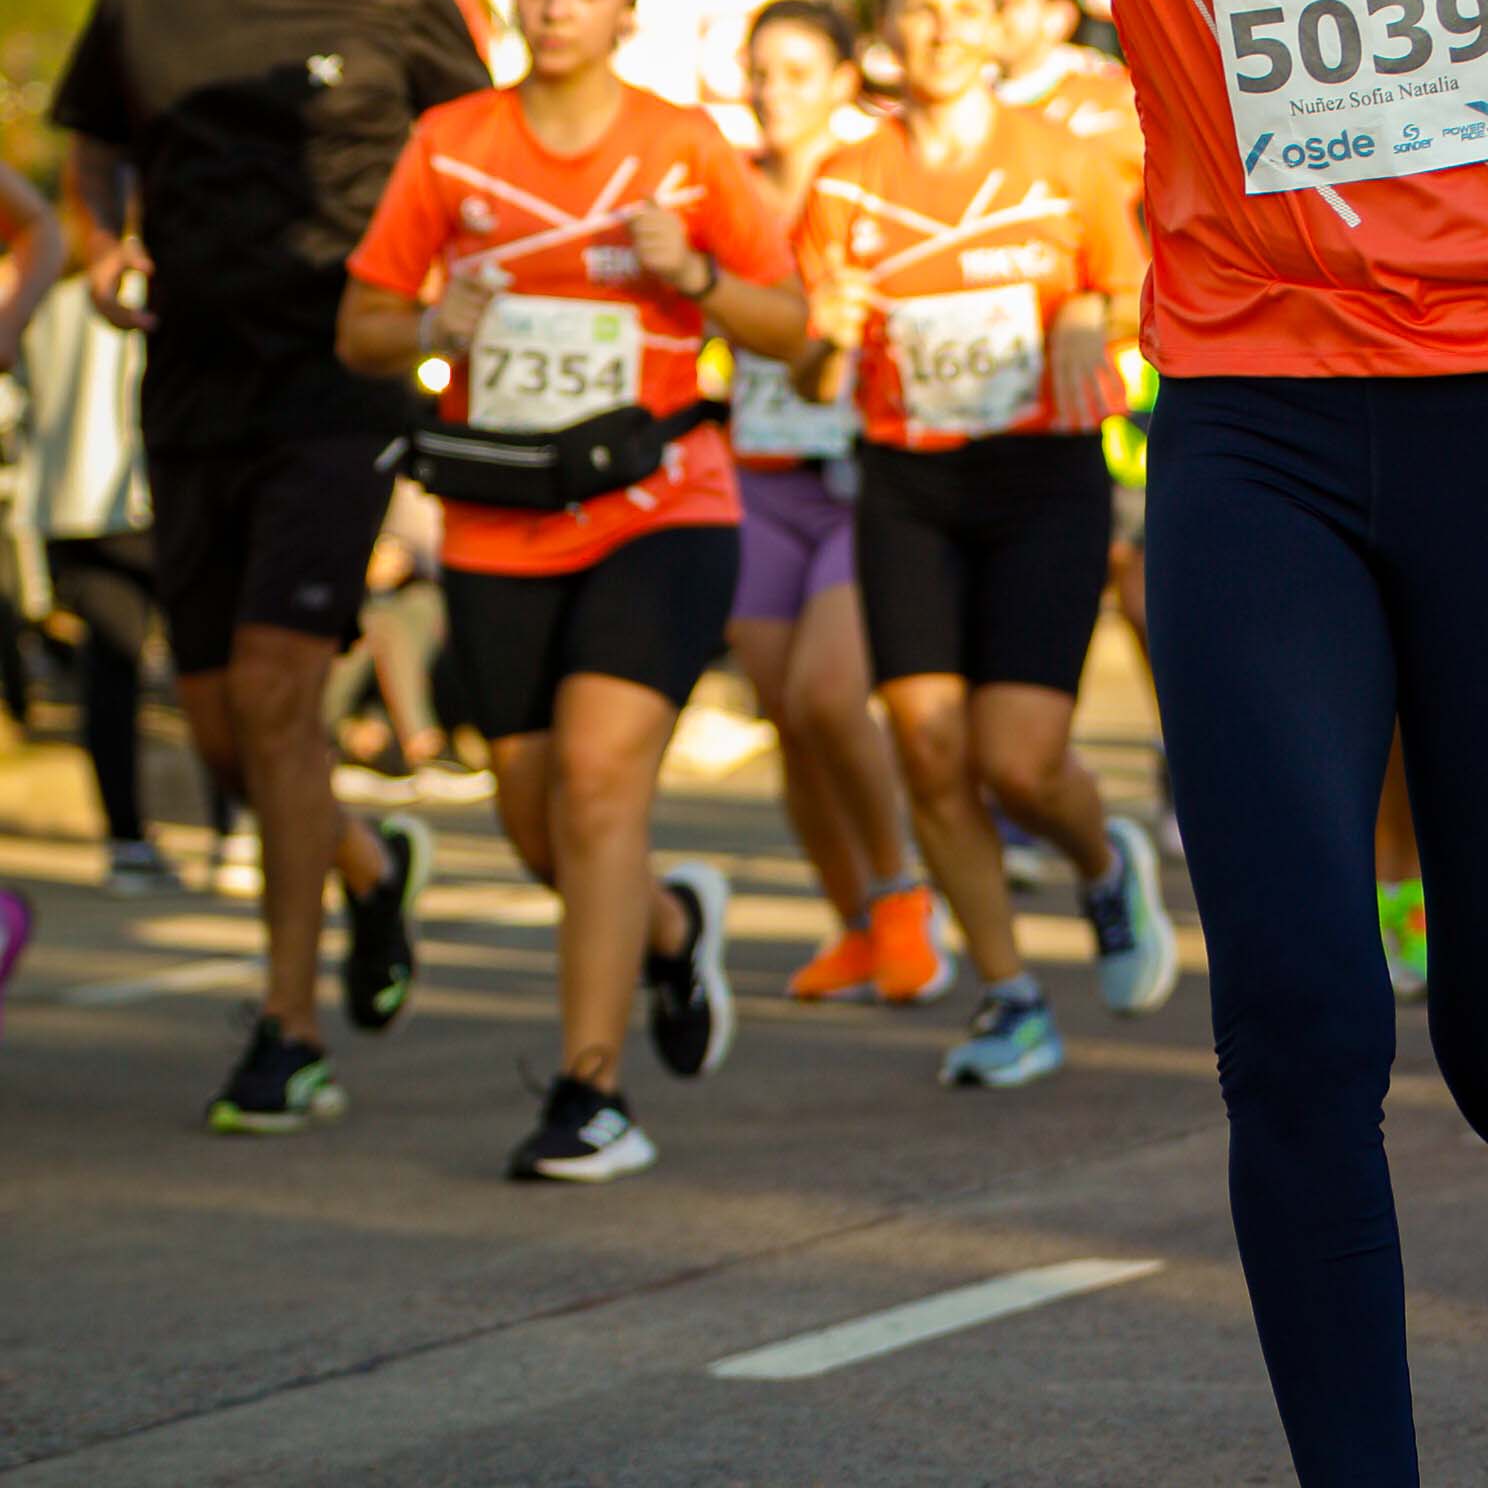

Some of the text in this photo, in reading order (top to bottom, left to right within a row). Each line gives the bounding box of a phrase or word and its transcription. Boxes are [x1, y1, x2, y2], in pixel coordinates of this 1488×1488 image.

[1289, 96, 1346, 116] Nuñez
[1398, 75, 1460, 101] Natalia
[1442, 120, 1486, 137] POWER
[1282, 129, 1376, 169] osde
[481, 345, 627, 398] 7354
